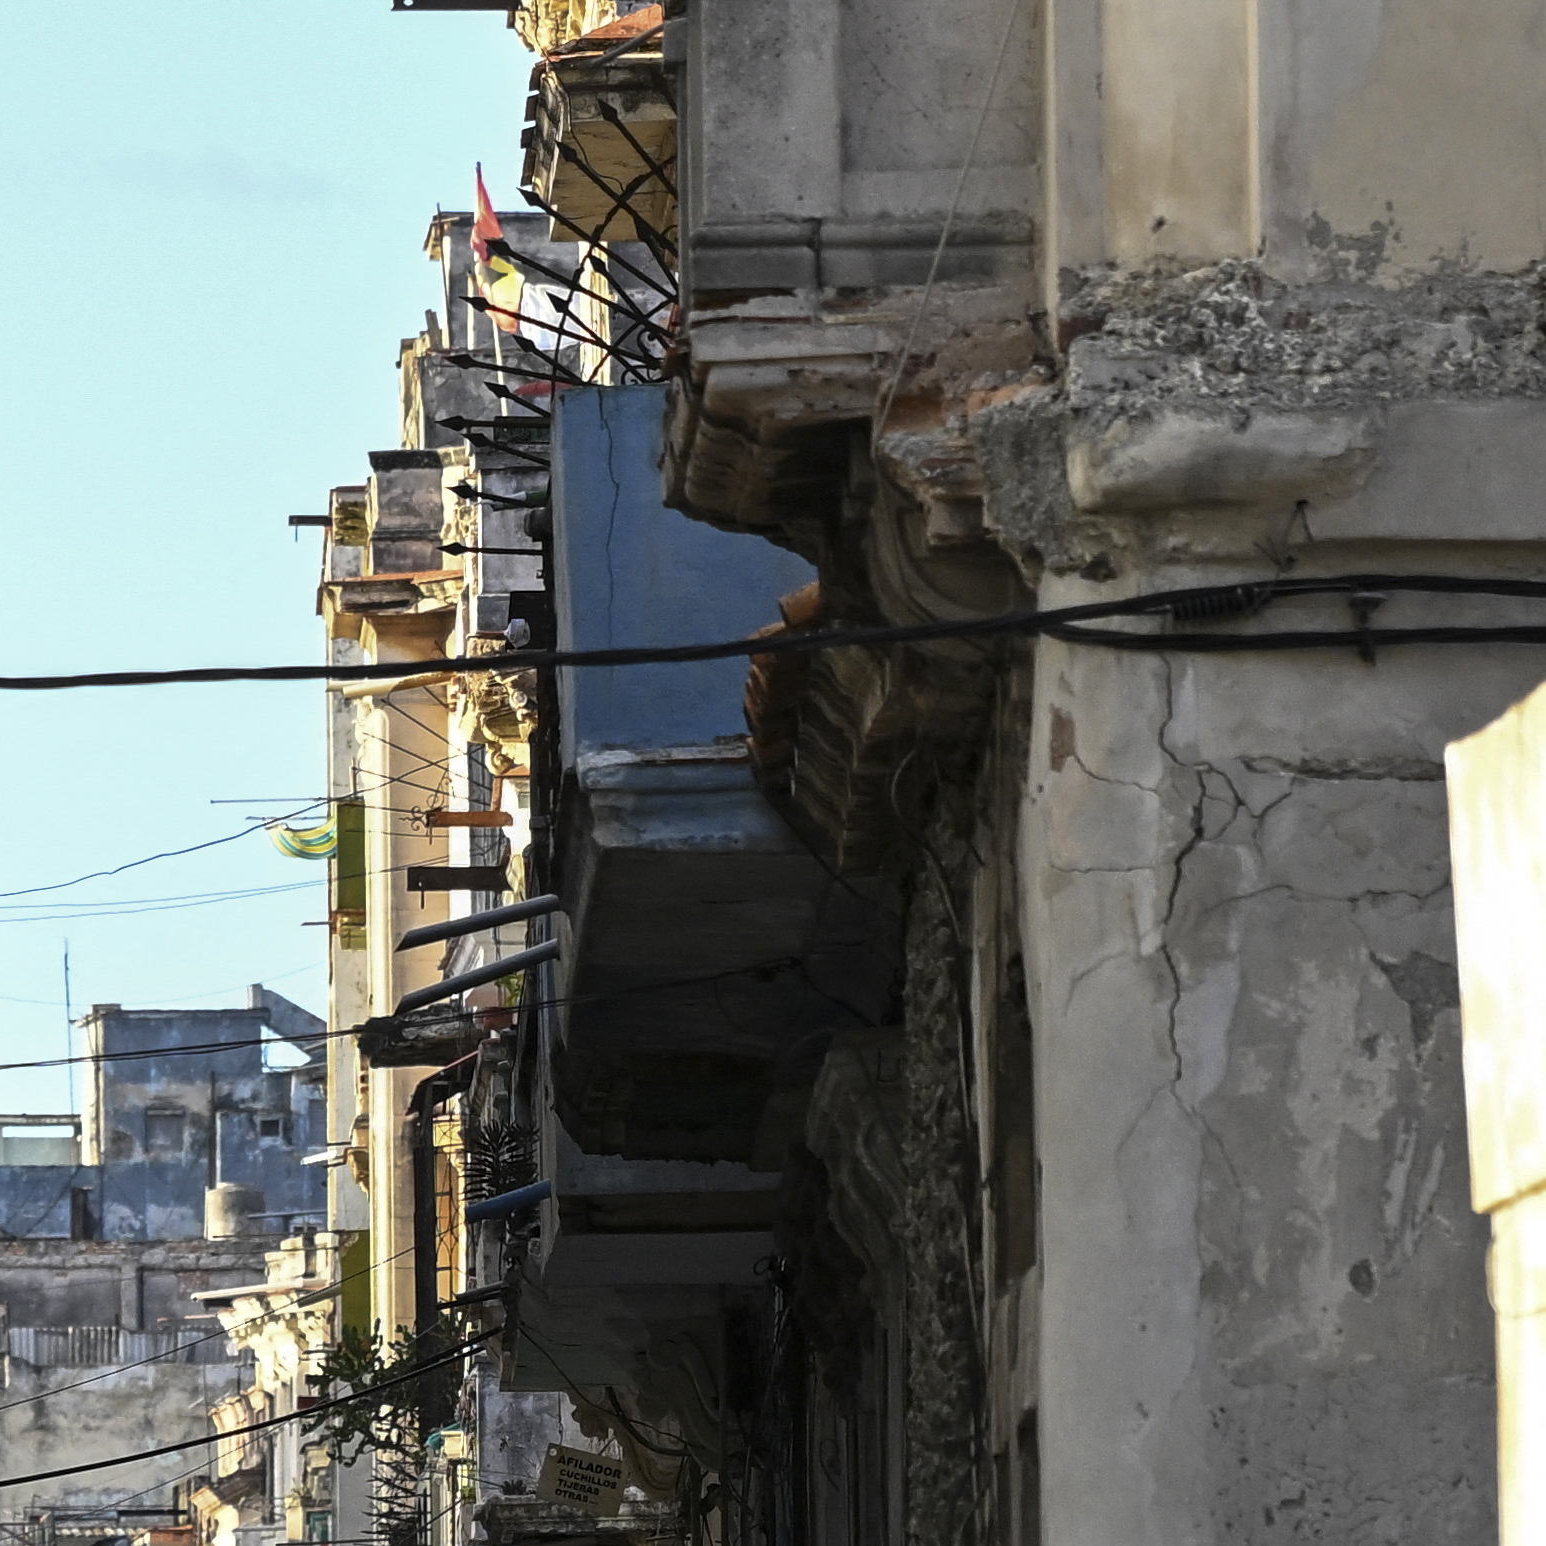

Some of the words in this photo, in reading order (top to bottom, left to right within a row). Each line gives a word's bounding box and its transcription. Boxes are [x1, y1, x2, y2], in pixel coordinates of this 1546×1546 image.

[557, 1456, 622, 1479] AFILADOR
[558, 1478, 599, 1495] TIJERAS
[560, 1469, 617, 1489] CUCHILLOS
